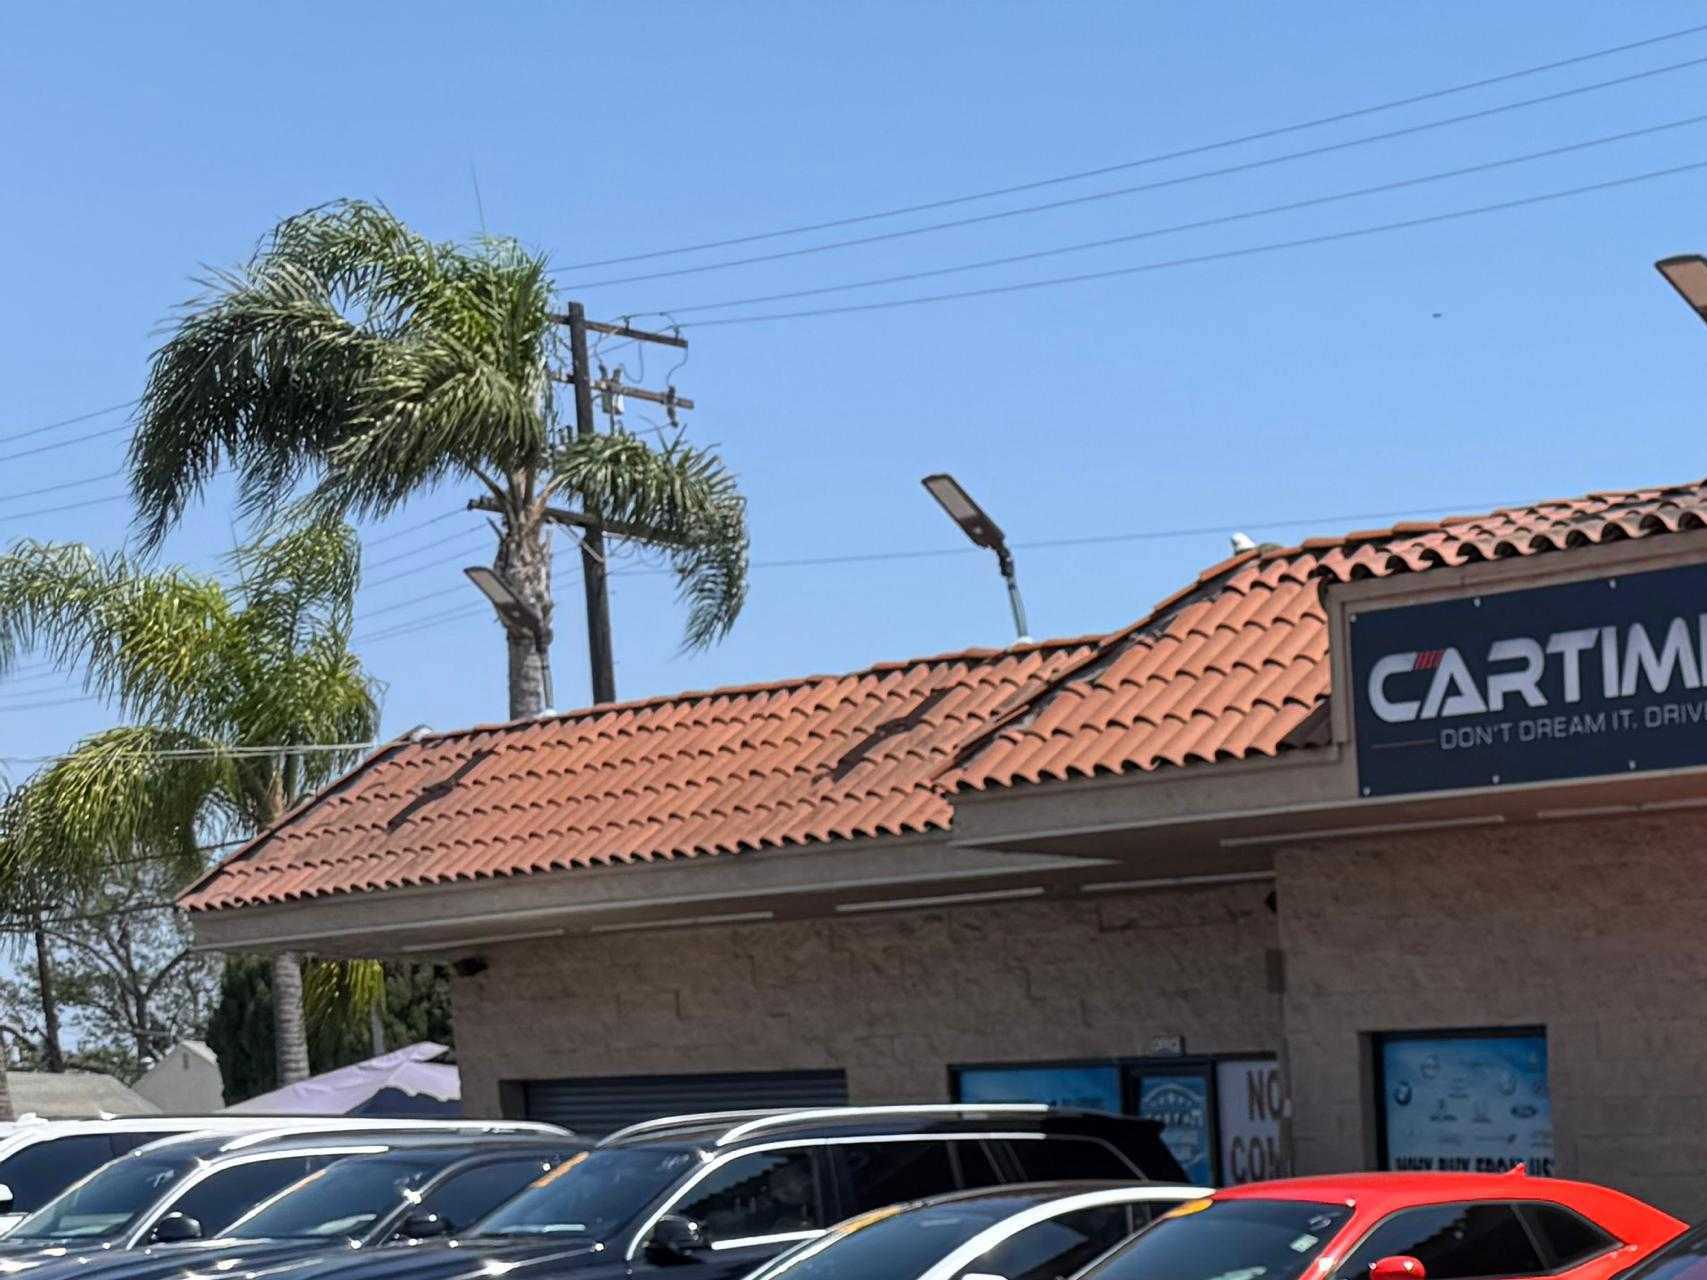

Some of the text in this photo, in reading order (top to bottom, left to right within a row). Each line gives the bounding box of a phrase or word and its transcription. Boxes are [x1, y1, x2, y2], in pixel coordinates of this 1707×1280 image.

[1440, 722, 1513, 750] DON'T
[1519, 714, 1604, 742] DREAM
[1612, 708, 1638, 731] IT.
